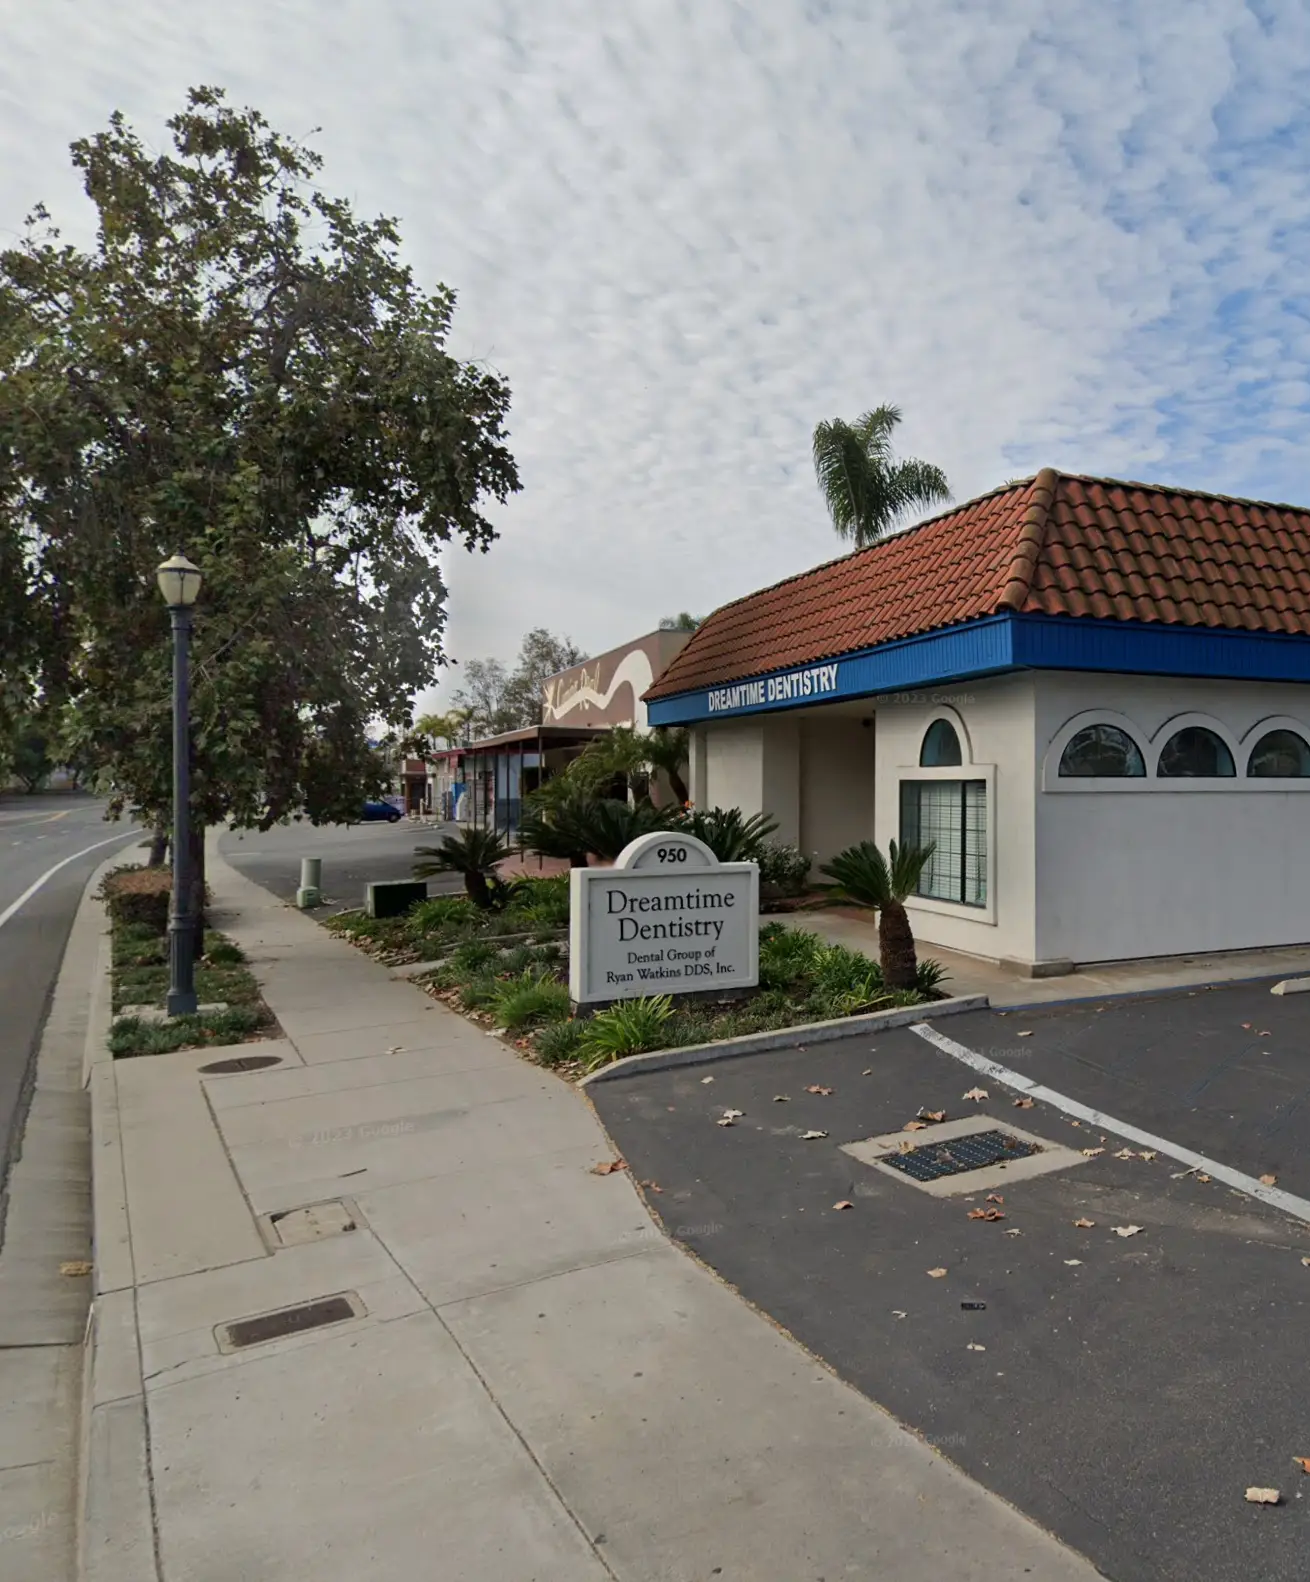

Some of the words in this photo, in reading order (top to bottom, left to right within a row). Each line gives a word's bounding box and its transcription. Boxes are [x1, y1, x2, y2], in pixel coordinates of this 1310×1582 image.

[708, 681, 766, 712] DREAMTIME
[767, 664, 839, 702] DENTISTRY
[657, 848, 687, 863] 950
[606, 889, 735, 914] Dreamtime
[618, 917, 724, 942] Dentistry
[627, 949, 664, 964] Dental
[667, 949, 701, 963] Group
[704, 946, 717, 959] of
[606, 971, 634, 985] Ryan
[637, 966, 681, 982] Watkins
[684, 963, 713, 977] DDS,
[716, 962, 735, 974] Inc.
